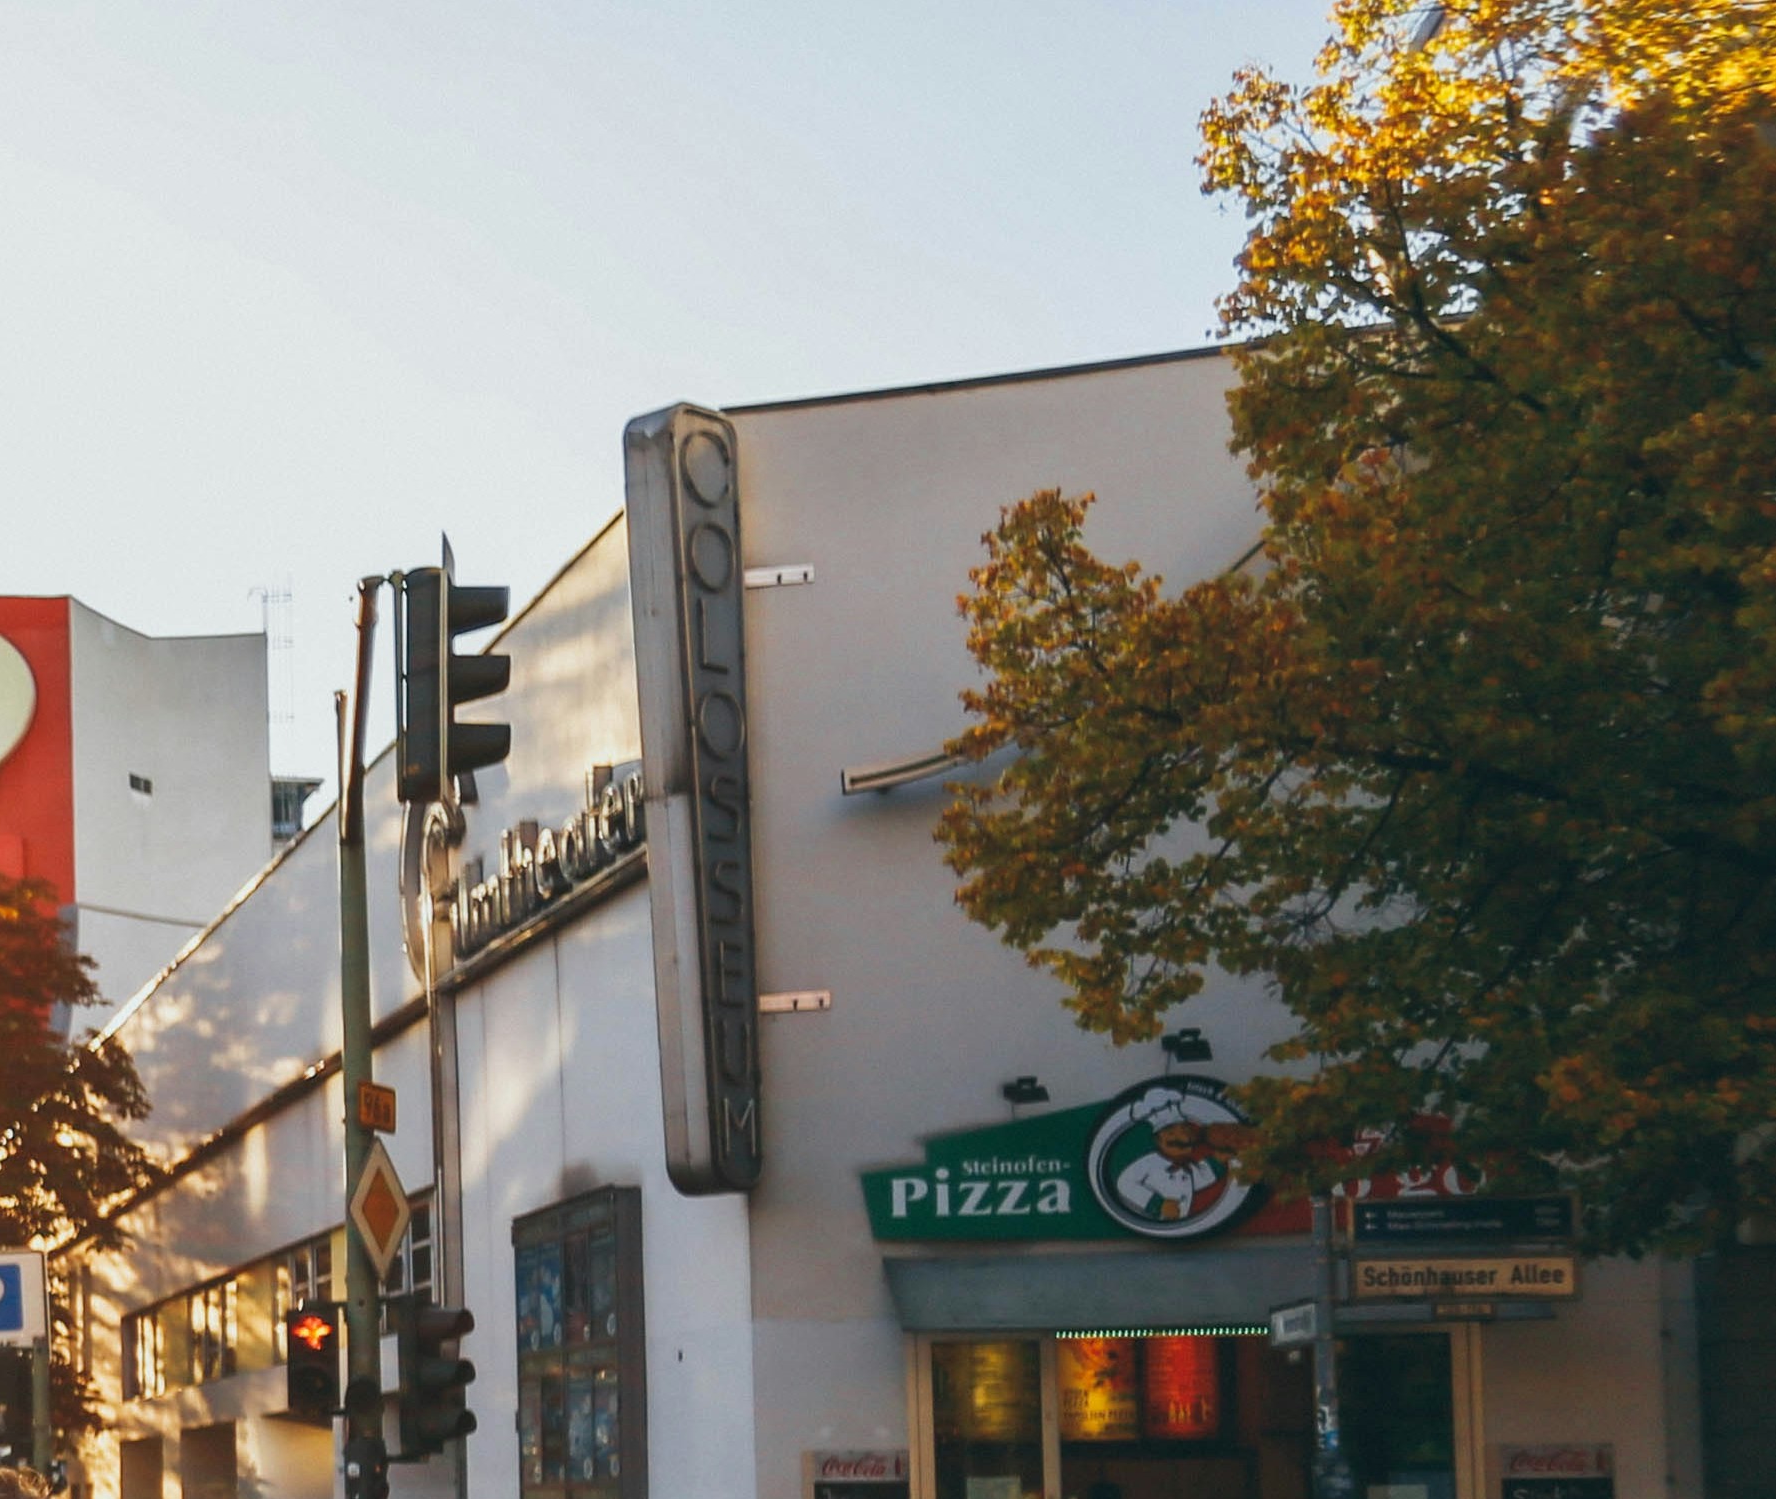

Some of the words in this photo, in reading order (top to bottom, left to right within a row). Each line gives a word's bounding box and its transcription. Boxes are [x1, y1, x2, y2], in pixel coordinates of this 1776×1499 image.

[681, 430, 757, 1158] COLOSSEUM
[891, 1167, 1072, 1218] Pizza
[1363, 1264, 1497, 1288] Schönhauser
[1510, 1263, 1566, 1285] Allee
